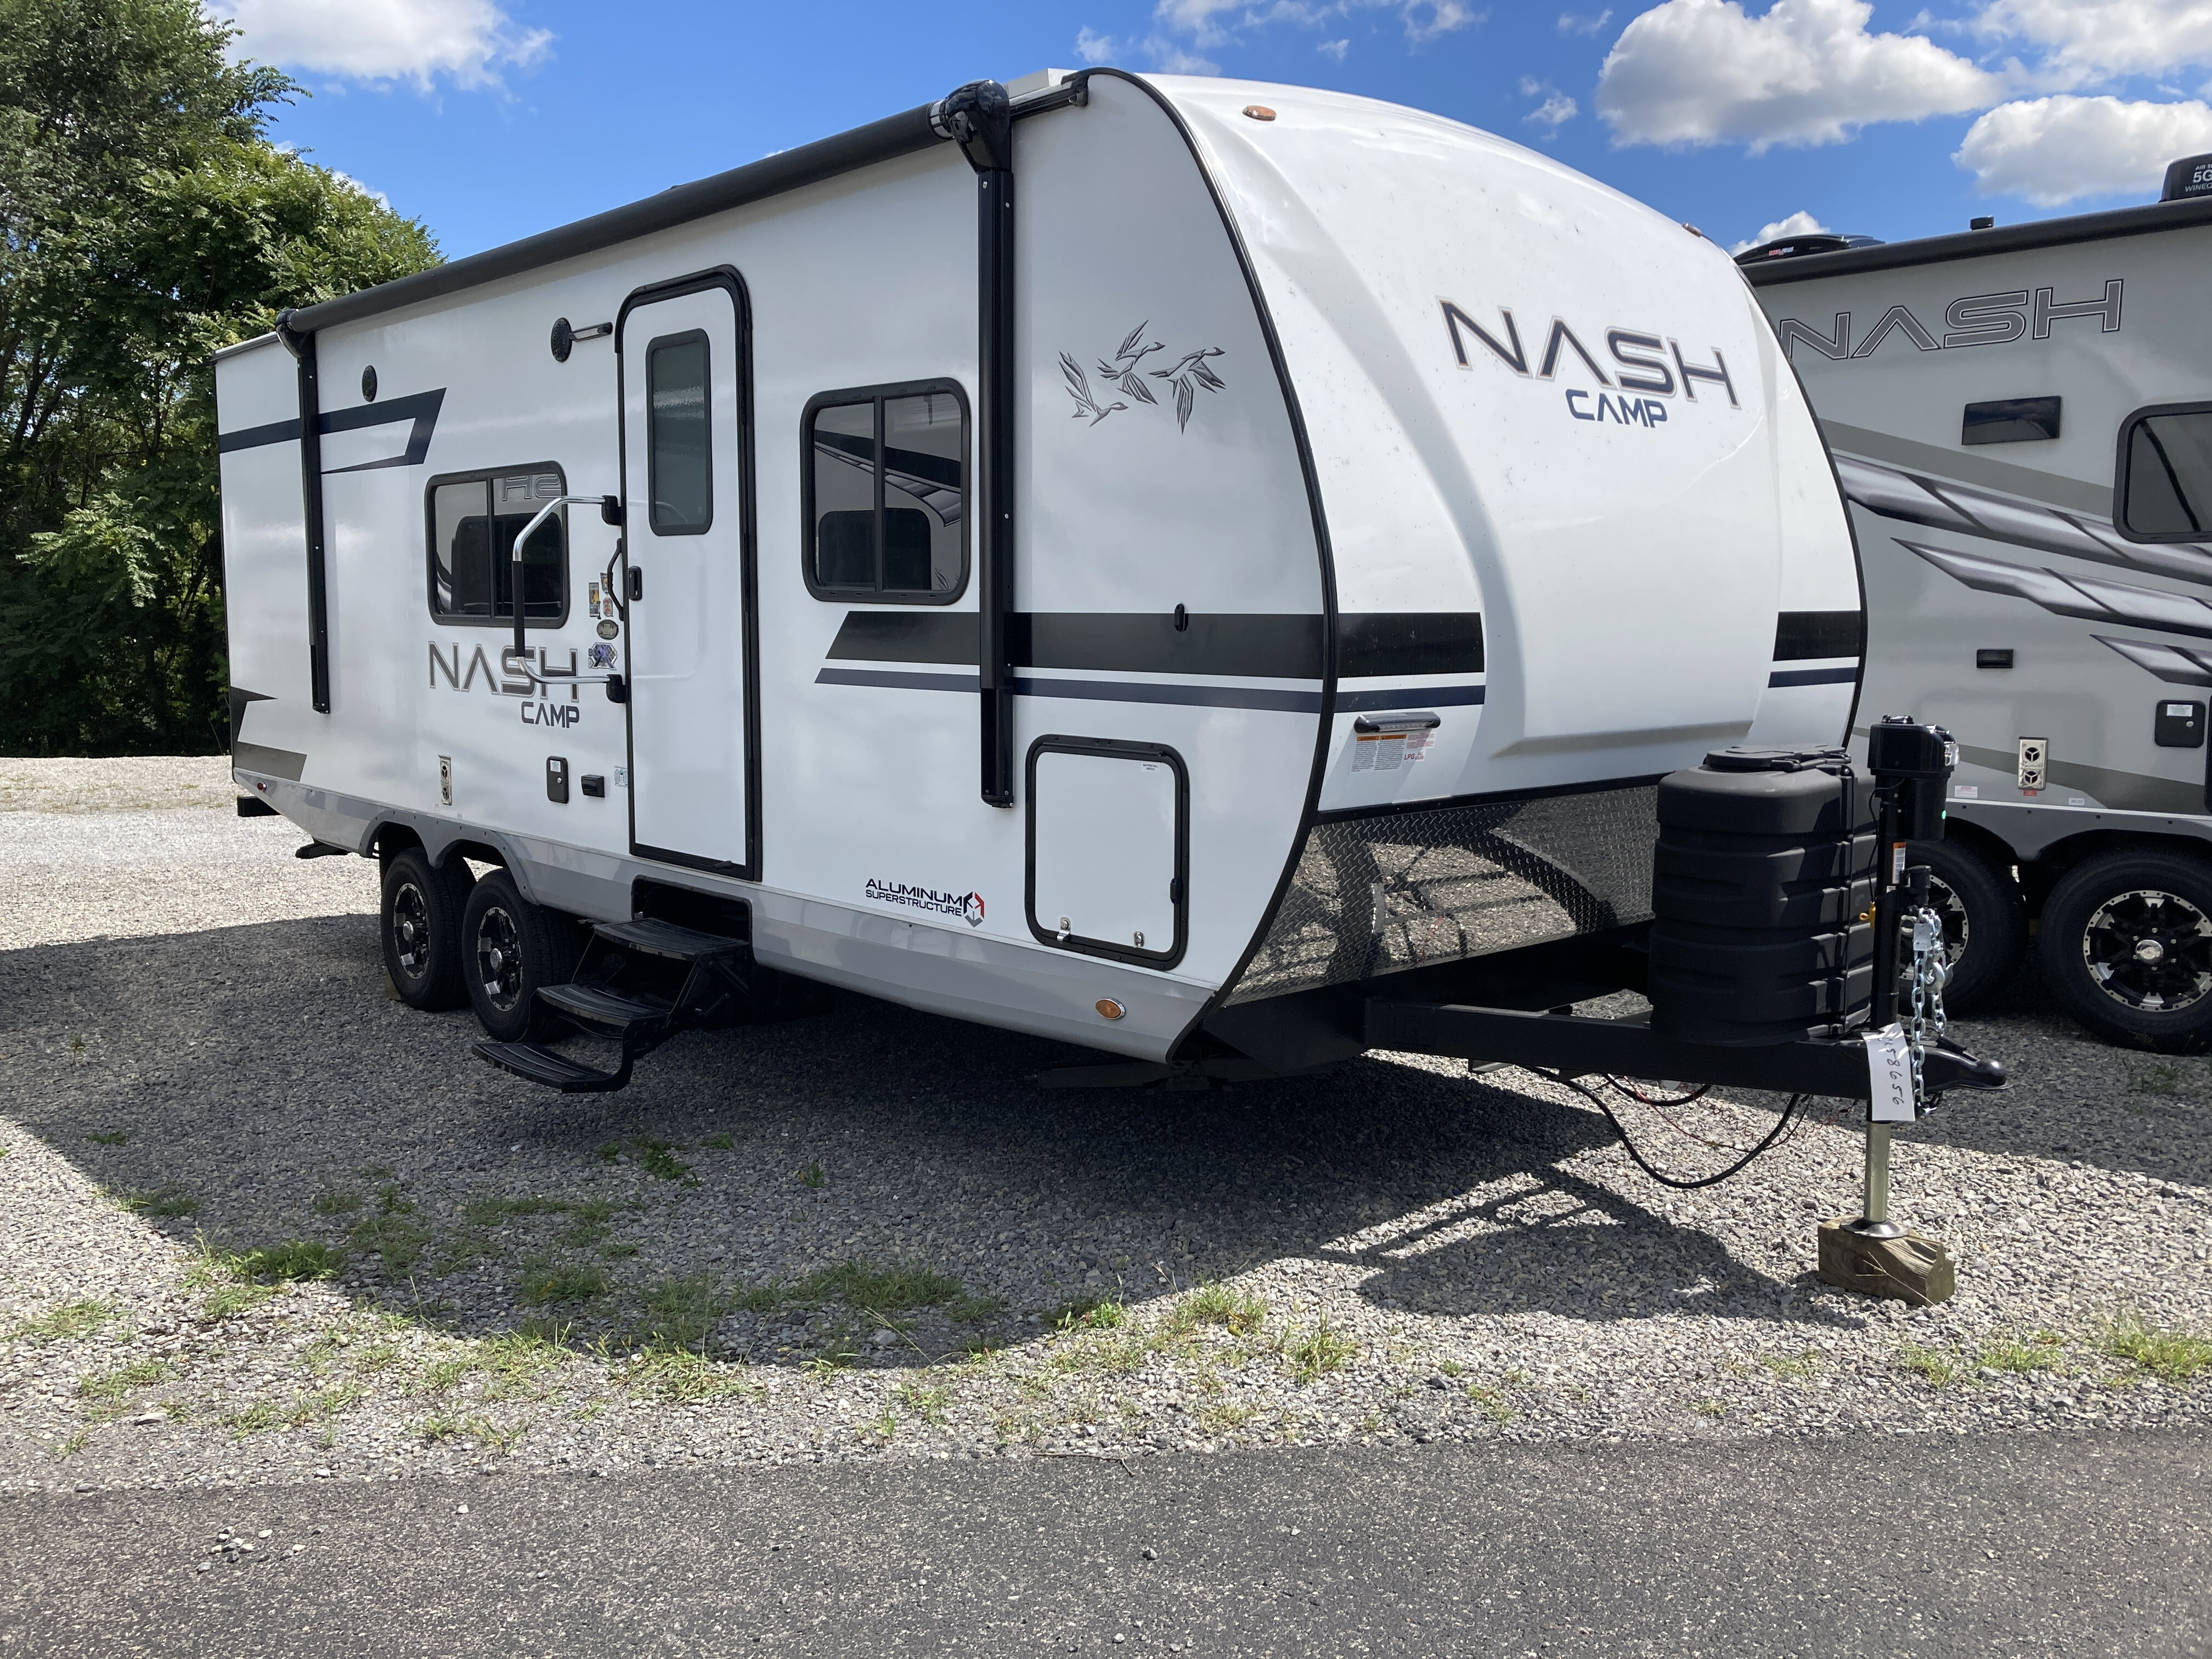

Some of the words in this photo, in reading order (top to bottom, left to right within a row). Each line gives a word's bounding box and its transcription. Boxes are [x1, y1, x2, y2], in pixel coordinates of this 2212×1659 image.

[2193, 170, 2212, 183] 5G
[1779, 278, 2124, 360] NASH
[1435, 295, 1742, 410] NASH
[1565, 388, 1668, 428] CAMP
[428, 640, 579, 703] NASH
[521, 701, 579, 728] CAMP
[865, 878, 962, 907] ALUMINUM
[865, 889, 962, 917] SUPERSTRUCTURE
